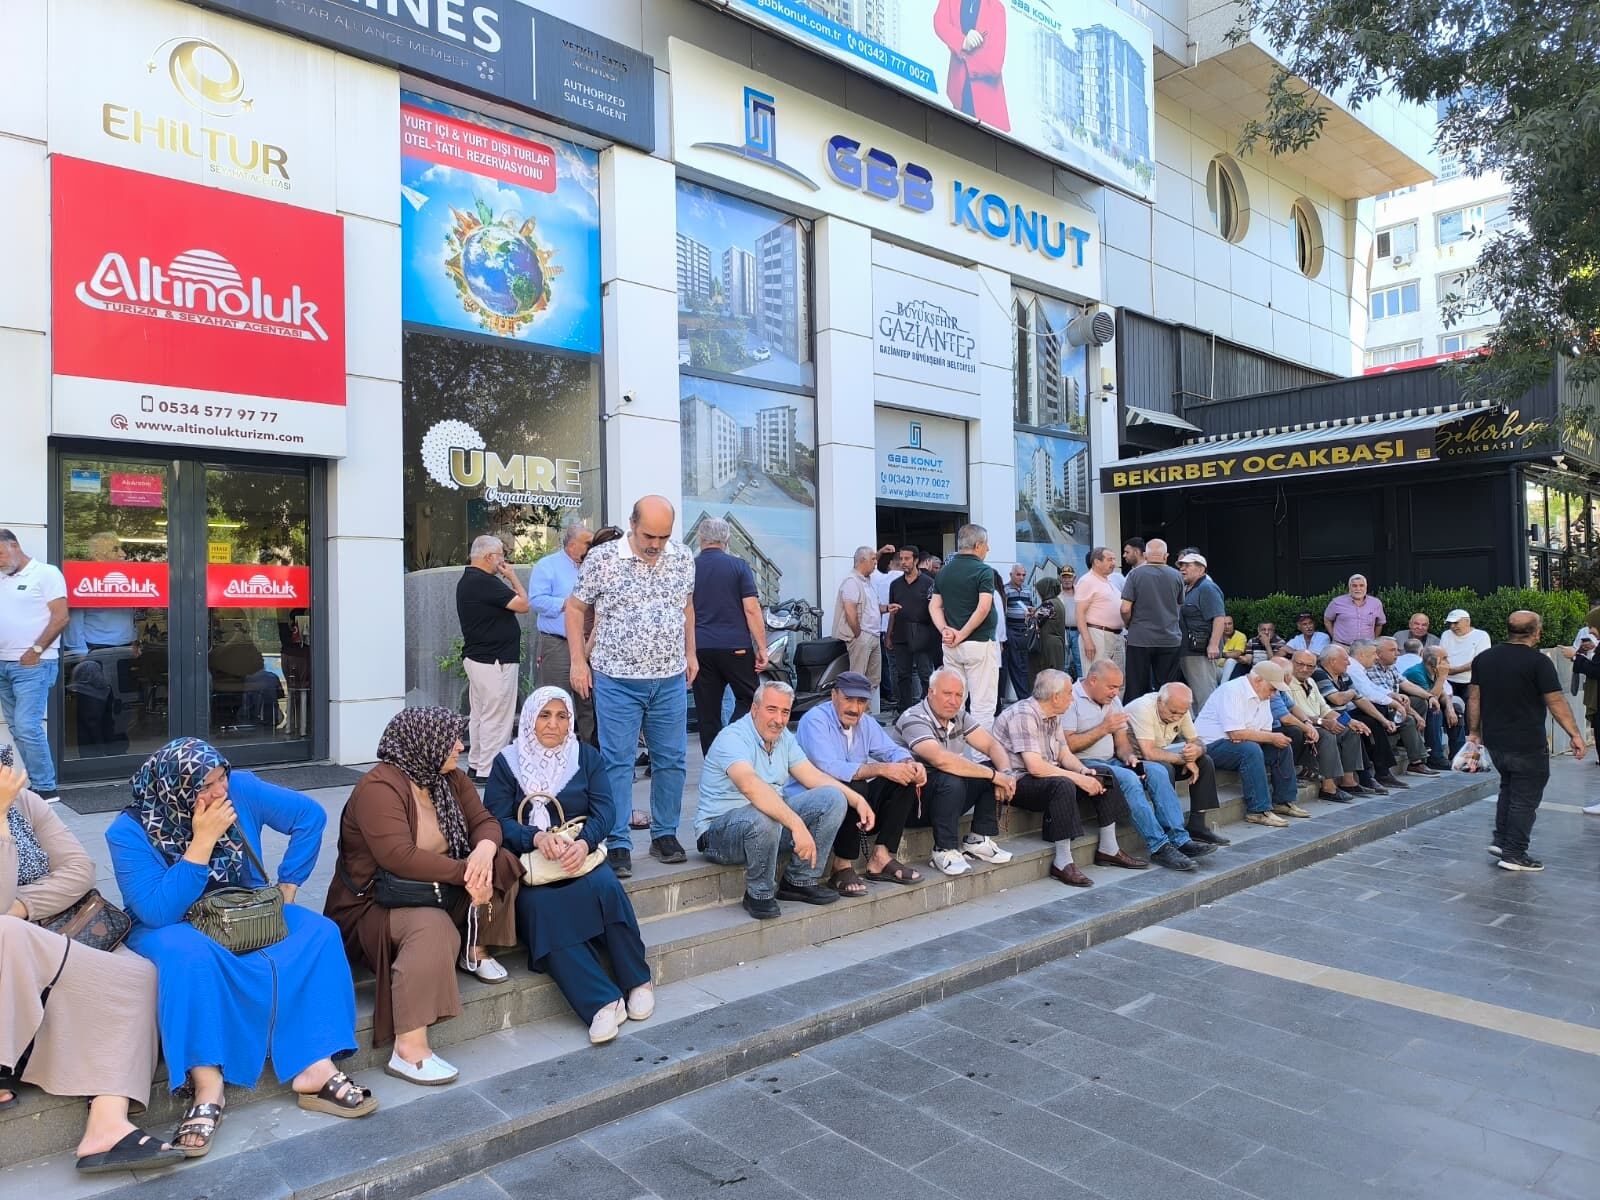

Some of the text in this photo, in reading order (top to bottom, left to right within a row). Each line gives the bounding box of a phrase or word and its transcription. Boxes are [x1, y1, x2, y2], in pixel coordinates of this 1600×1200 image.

[1032, 7, 1063, 31] KONUT
[858, 40, 889, 61] 0(342)
[890, 56, 908, 72] 777
[909, 66, 931, 84] 0027
[563, 78, 626, 108] AUTHORIZED
[563, 91, 628, 122] SALES AGENT
[404, 114, 433, 133] YURT
[451, 128, 460, 141] &
[462, 131, 489, 149] YURT
[491, 140, 511, 157] DIŞI
[513, 146, 551, 167] TURLAR
[404, 132, 544, 181] OTEL-TATİL REZERVASYONU
[822, 133, 1092, 271] GBB KONUT
[164, 310, 174, 319] &
[178, 312, 239, 329] SEYAHAT
[879, 315, 976, 361] GAZİANTEP
[158, 400, 278, 424] 0534 577 97 77
[134, 419, 305, 444] www.altinolukturizm.com
[910, 455, 944, 468] KONUT
[1241, 438, 1406, 475] OCAKBAŞI
[1447, 440, 1515, 457] OCAKBAŞI
[449, 446, 583, 495] UMRE
[888, 472, 951, 489] 0(342) 777 0027
[485, 486, 583, 511] Organizasyonu
